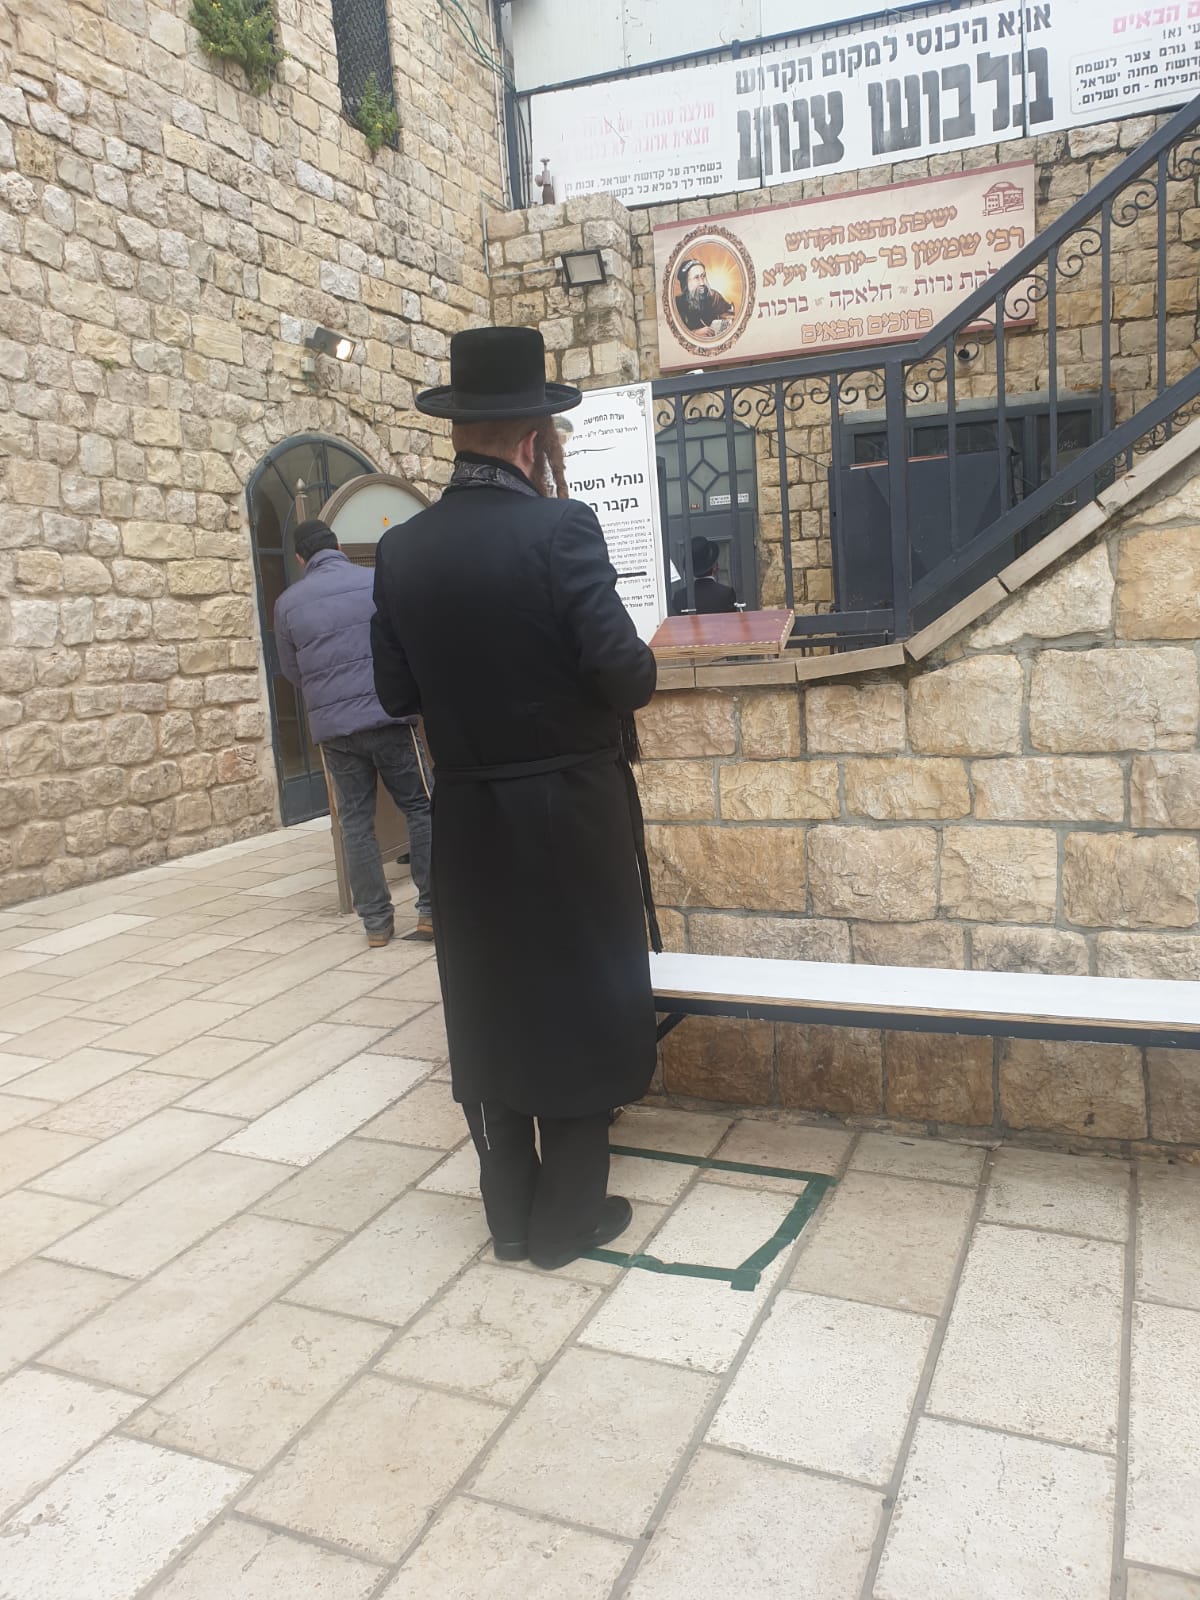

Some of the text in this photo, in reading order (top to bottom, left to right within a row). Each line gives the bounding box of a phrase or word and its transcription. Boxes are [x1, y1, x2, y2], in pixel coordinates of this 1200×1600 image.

[1112, 5, 1180, 34] הבאים
[735, 3, 1052, 94] אנא היכנסי למקום הקדוש
[1159, 43, 1186, 57] גורם
[1125, 50, 1151, 63] צער
[1166, 56, 1200, 71] דושת
[1075, 57, 1117, 75] לנשמת
[1128, 64, 1158, 79] מחנה
[1154, 72, 1200, 88] תפילות
[1123, 83, 1140, 95] חס
[737, 47, 1053, 181] בלבוש צנוע
[668, 167, 680, 176] על
[683, 161, 722, 174] בשמירה
[633, 170, 664, 183] קדושת
[696, 175, 723, 187] יעמוד
[637, 185, 649, 195] כל
[652, 180, 680, 193] למלא
[681, 179, 693, 191] לך
[785, 205, 957, 251] ישיבת התנא הקדוש
[985, 226, 1025, 250] רבי
[911, 231, 981, 269] שמעון
[914, 273, 953, 296] נרות
[830, 280, 892, 310] חלאקה
[757, 295, 809, 318] ברכות
[801, 308, 933, 344] ברוכים הבאים
[570, 472, 644, 492] נוהלי השהי
[603, 497, 639, 512] בקבר
